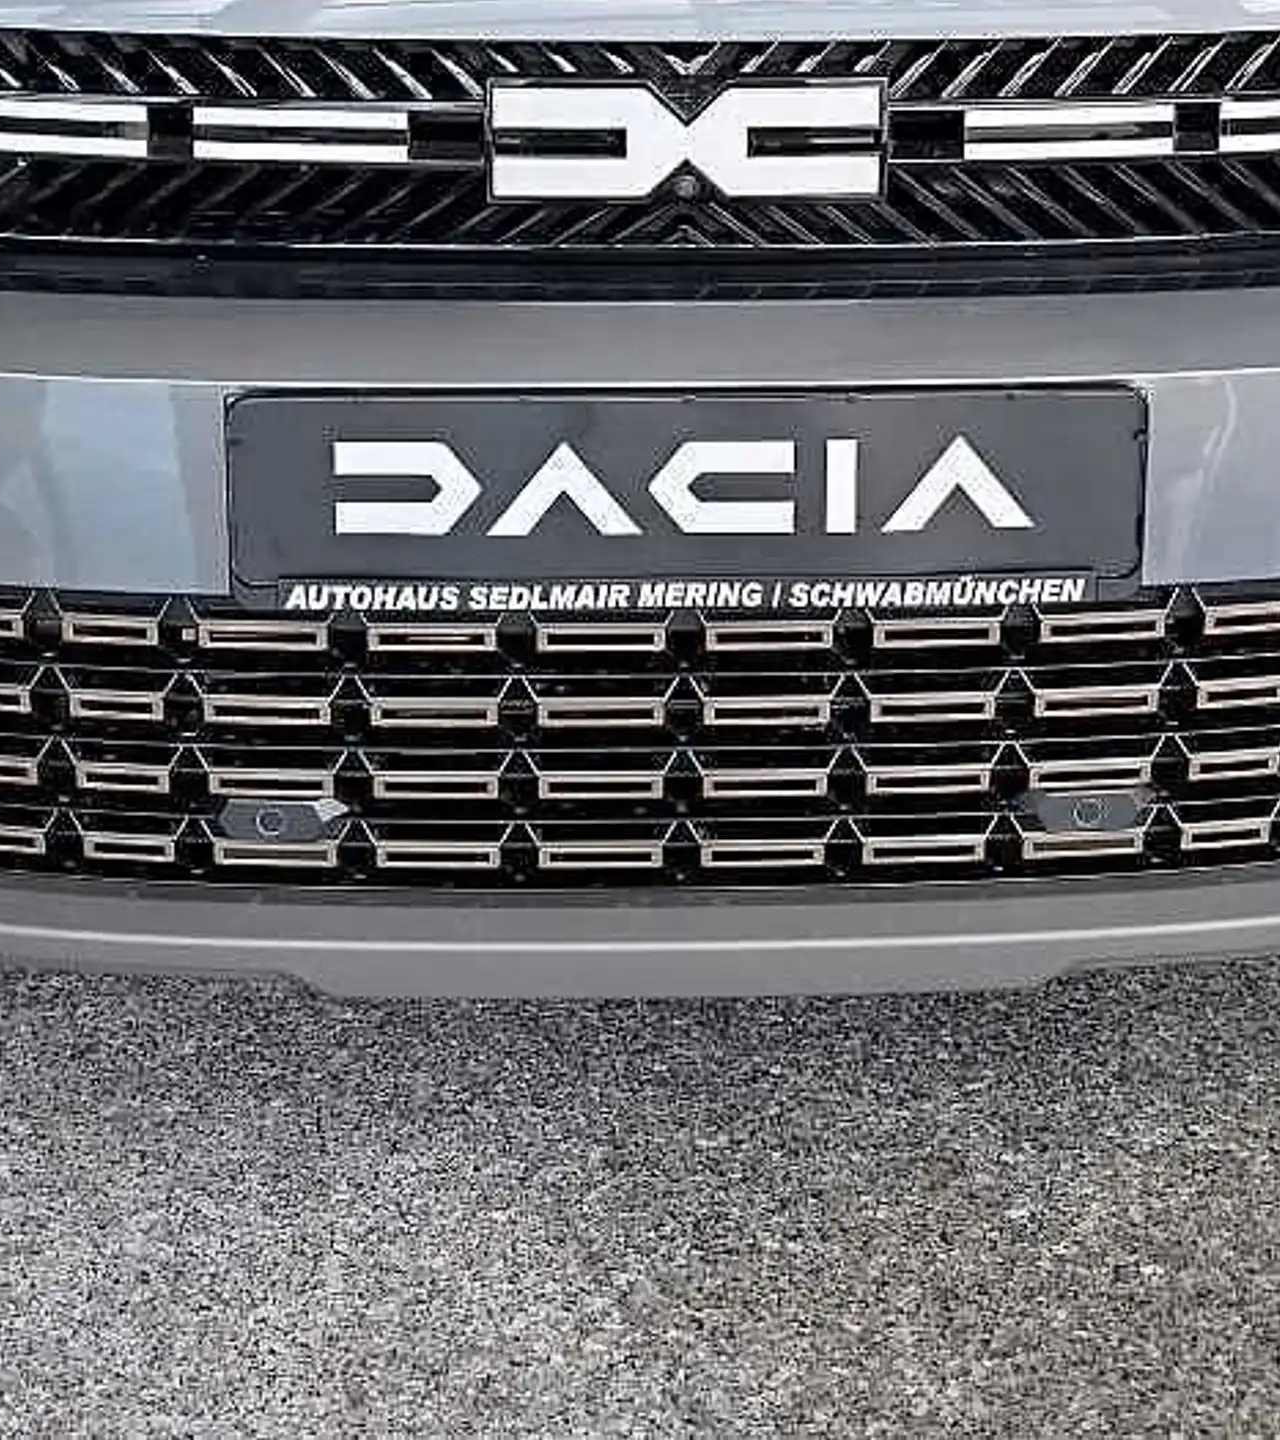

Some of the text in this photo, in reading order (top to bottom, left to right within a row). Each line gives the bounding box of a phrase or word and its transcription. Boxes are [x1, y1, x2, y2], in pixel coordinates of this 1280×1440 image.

[333, 434, 1036, 538] DACIA
[285, 585, 461, 610] AUTOHAUS
[469, 584, 630, 610] SEDLMAIR
[637, 582, 764, 608] MERING
[788, 575, 1087, 607] SCHWABMÜNCHEN
